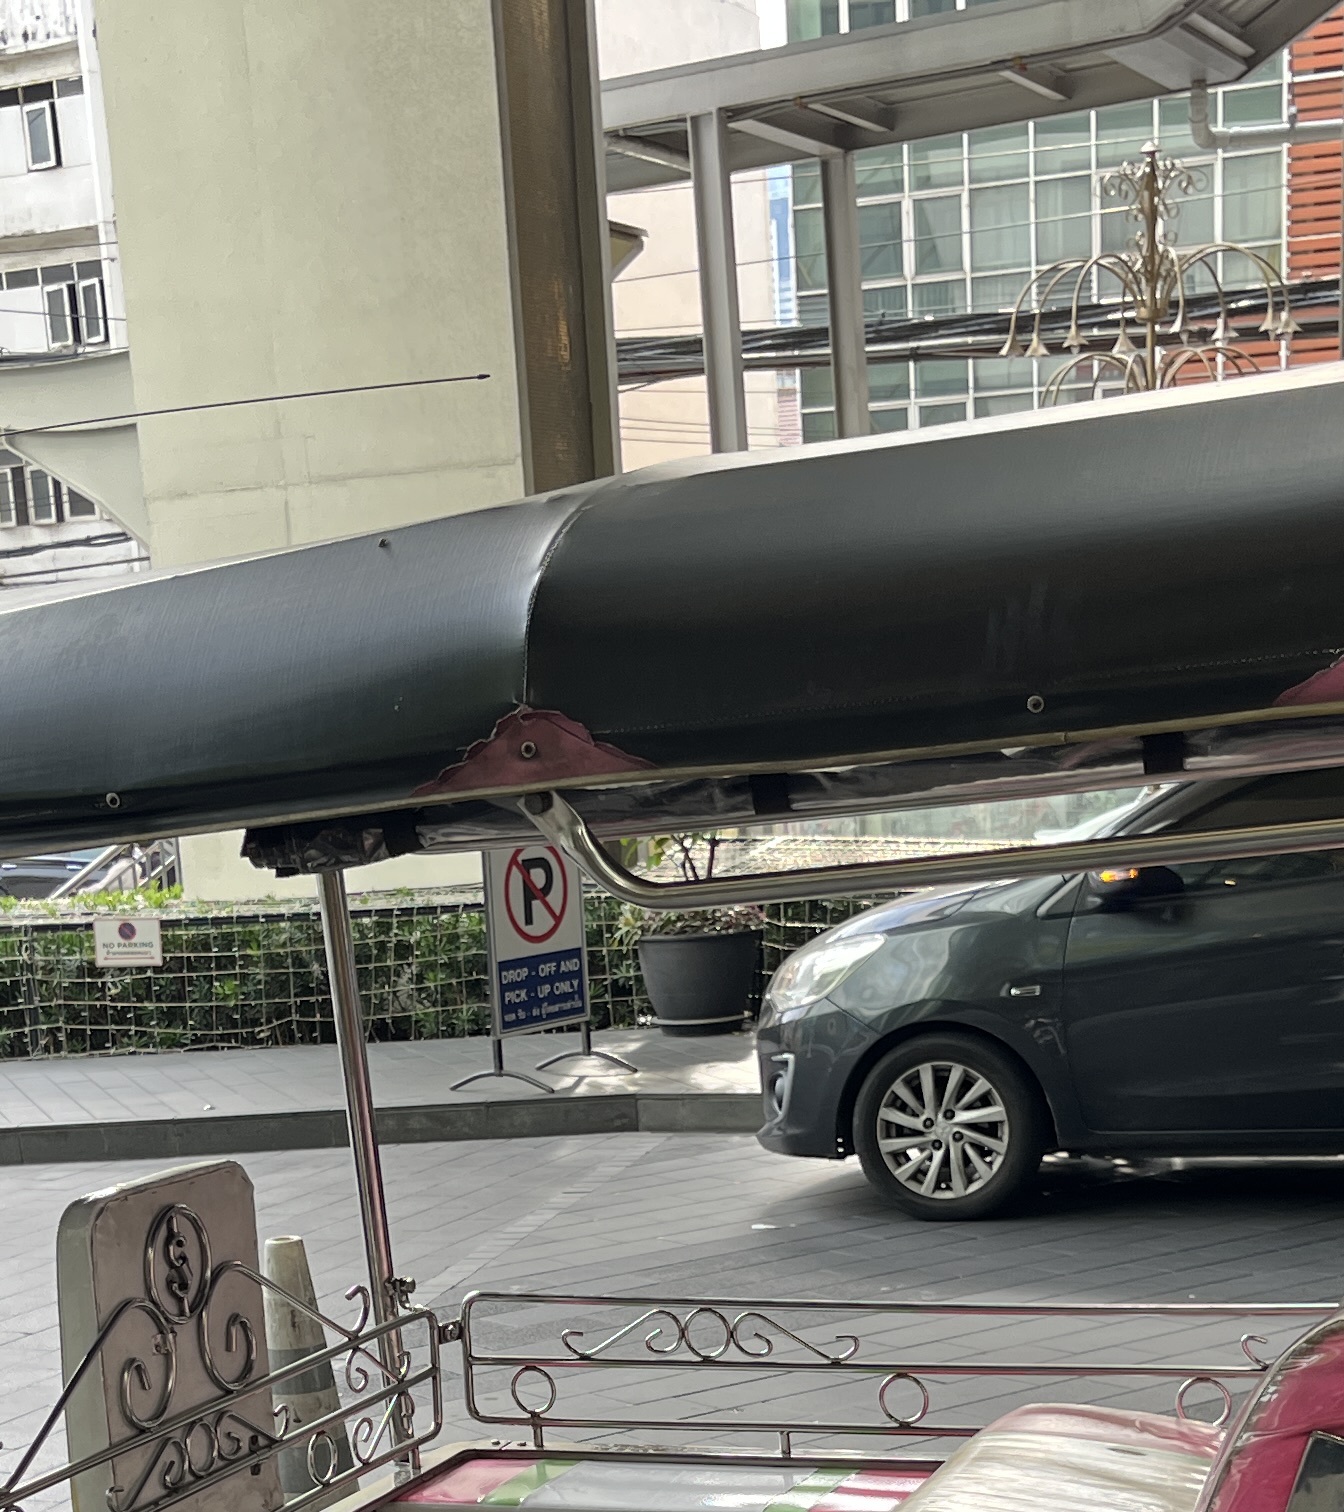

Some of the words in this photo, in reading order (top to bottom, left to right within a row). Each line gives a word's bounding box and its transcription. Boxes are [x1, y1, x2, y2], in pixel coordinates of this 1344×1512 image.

[501, 967, 529, 985] DROP
[538, 962, 557, 978] OFF
[559, 958, 580, 973] AND
[504, 989, 528, 1006] PICK
[537, 984, 551, 999] UP
[553, 979, 579, 995] ONLY
